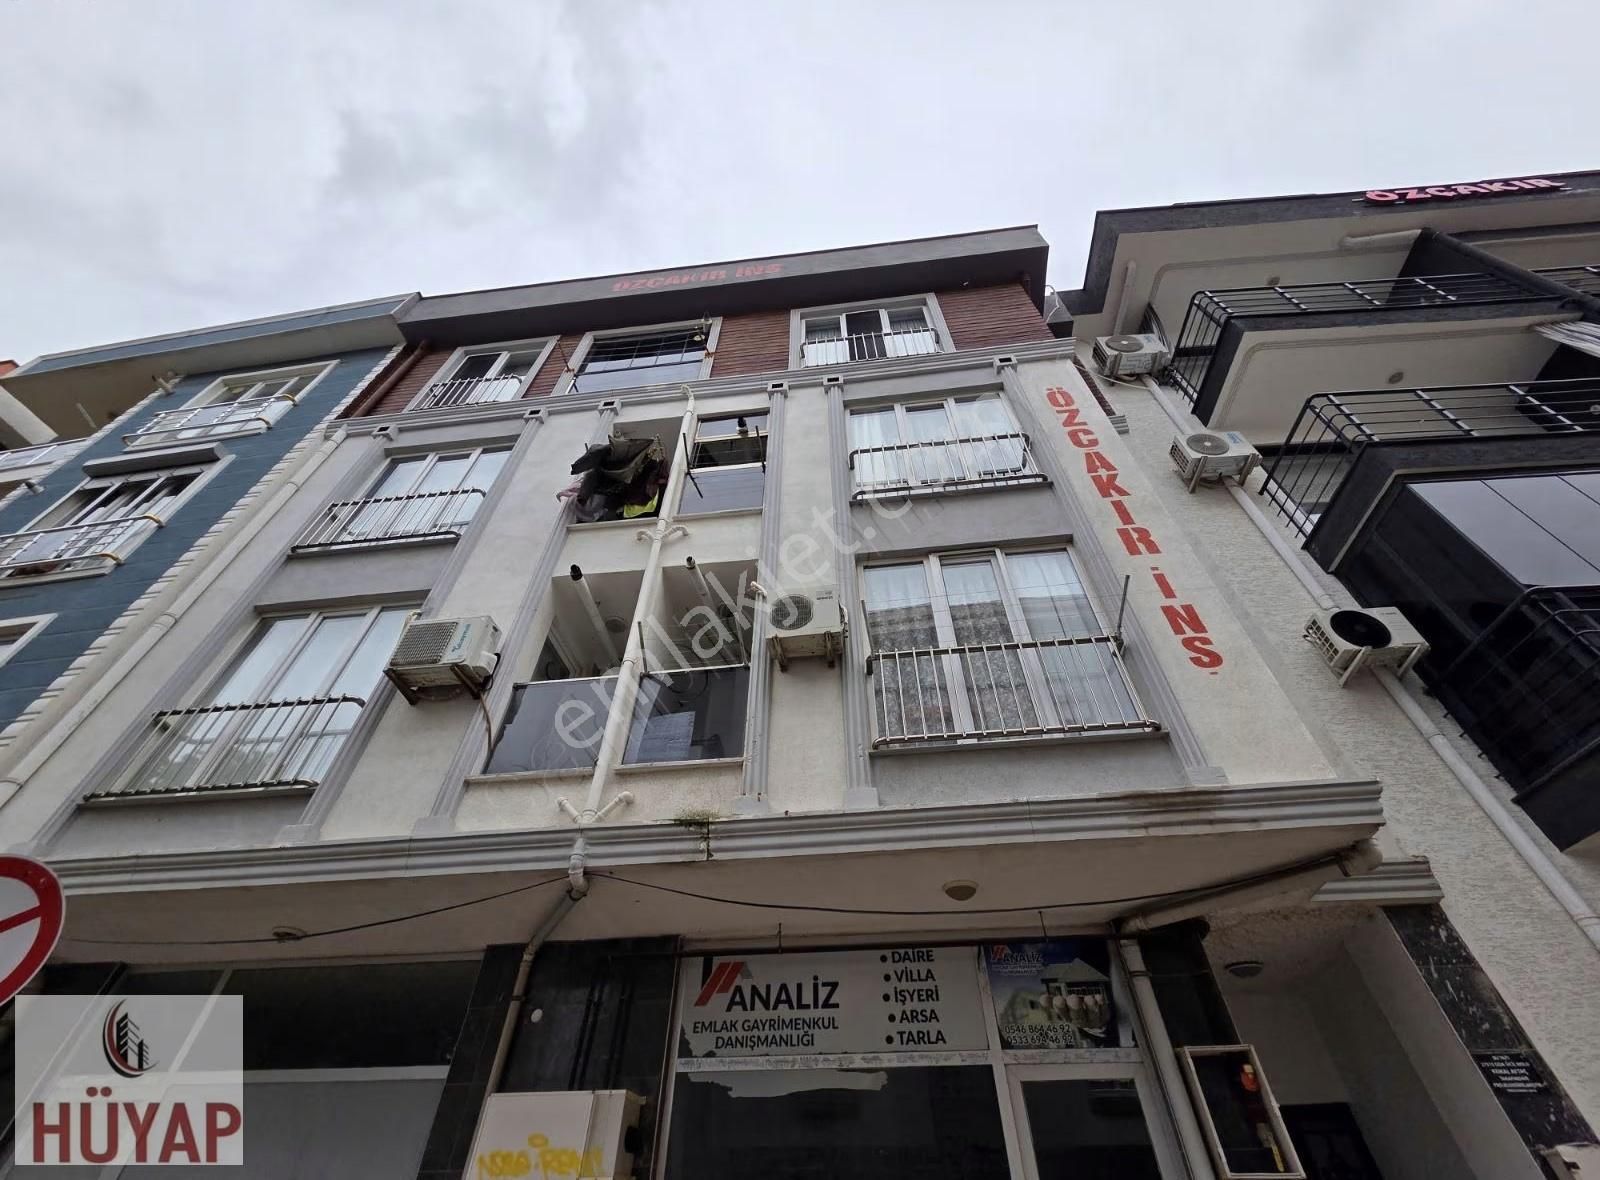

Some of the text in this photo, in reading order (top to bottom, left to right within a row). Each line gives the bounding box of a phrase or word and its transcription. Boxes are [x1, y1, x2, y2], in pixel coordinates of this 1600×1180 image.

[891, 948, 935, 964] DAİRE
[894, 966, 937, 984] VİLLA
[725, 975, 840, 1013] ANALİZ
[894, 985, 940, 1006] İŞYERİ
[692, 1014, 839, 1034] EMLAK GAYRİMENKUL
[899, 1008, 940, 1024] ARSA
[714, 1030, 815, 1051] DANIŞMANLIĞI
[896, 1029, 947, 1046] TARLA
